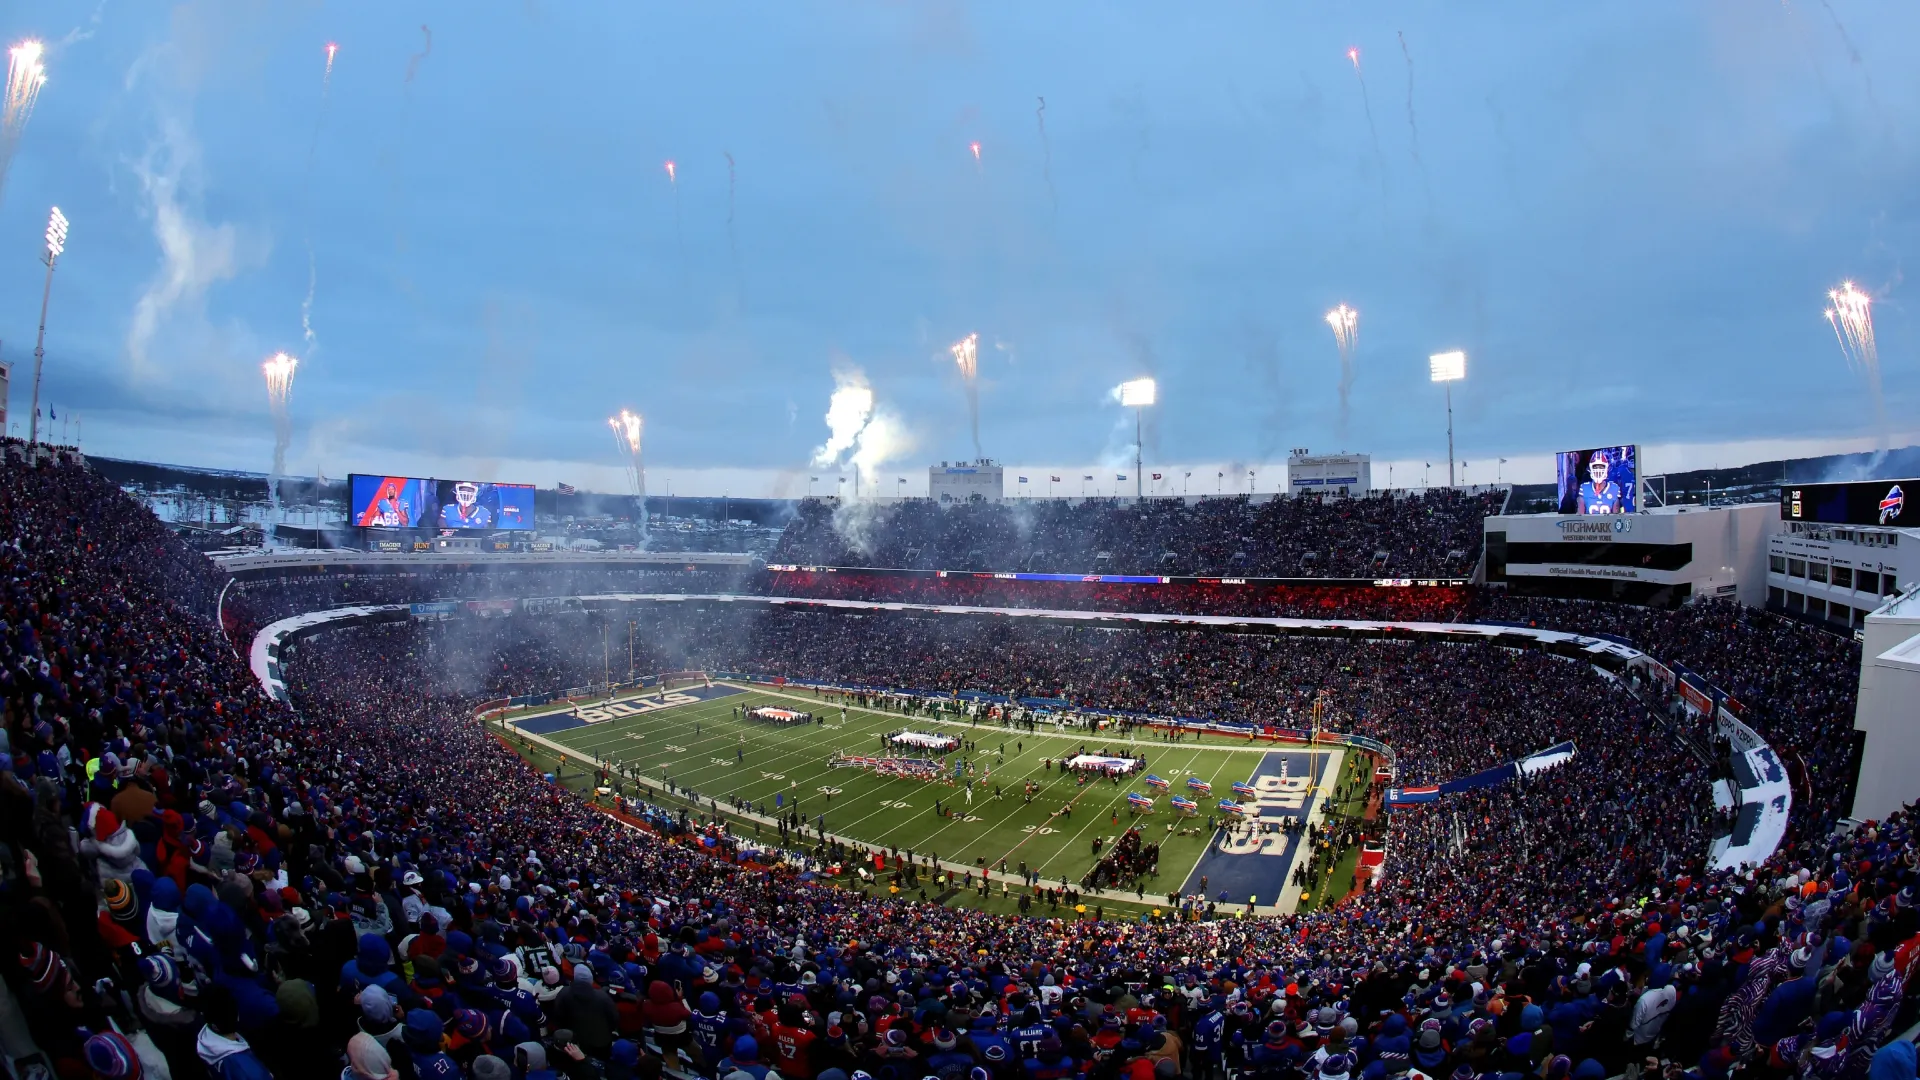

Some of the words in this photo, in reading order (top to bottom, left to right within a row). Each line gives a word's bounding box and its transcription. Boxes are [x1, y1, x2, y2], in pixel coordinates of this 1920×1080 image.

[1562, 522, 1612, 533] HIGHMARK
[1549, 567, 1568, 575] Official
[567, 693, 701, 723] BILLS
[1721, 716, 1735, 733] ZIPPO
[1739, 730, 1754, 748] ZIPPO
[879, 799, 908, 809] 40
[1021, 825, 1054, 835] 20
[131, 941, 143, 955] 8
[528, 951, 550, 974] 15
[698, 1022, 715, 1032] ALLEN
[1020, 1029, 1043, 1037] WILLIAMS
[700, 1031, 718, 1047] 17
[778, 1035, 795, 1045] ALLEN
[777, 1042, 797, 1059] 17
[433, 1057, 450, 1075] 27
